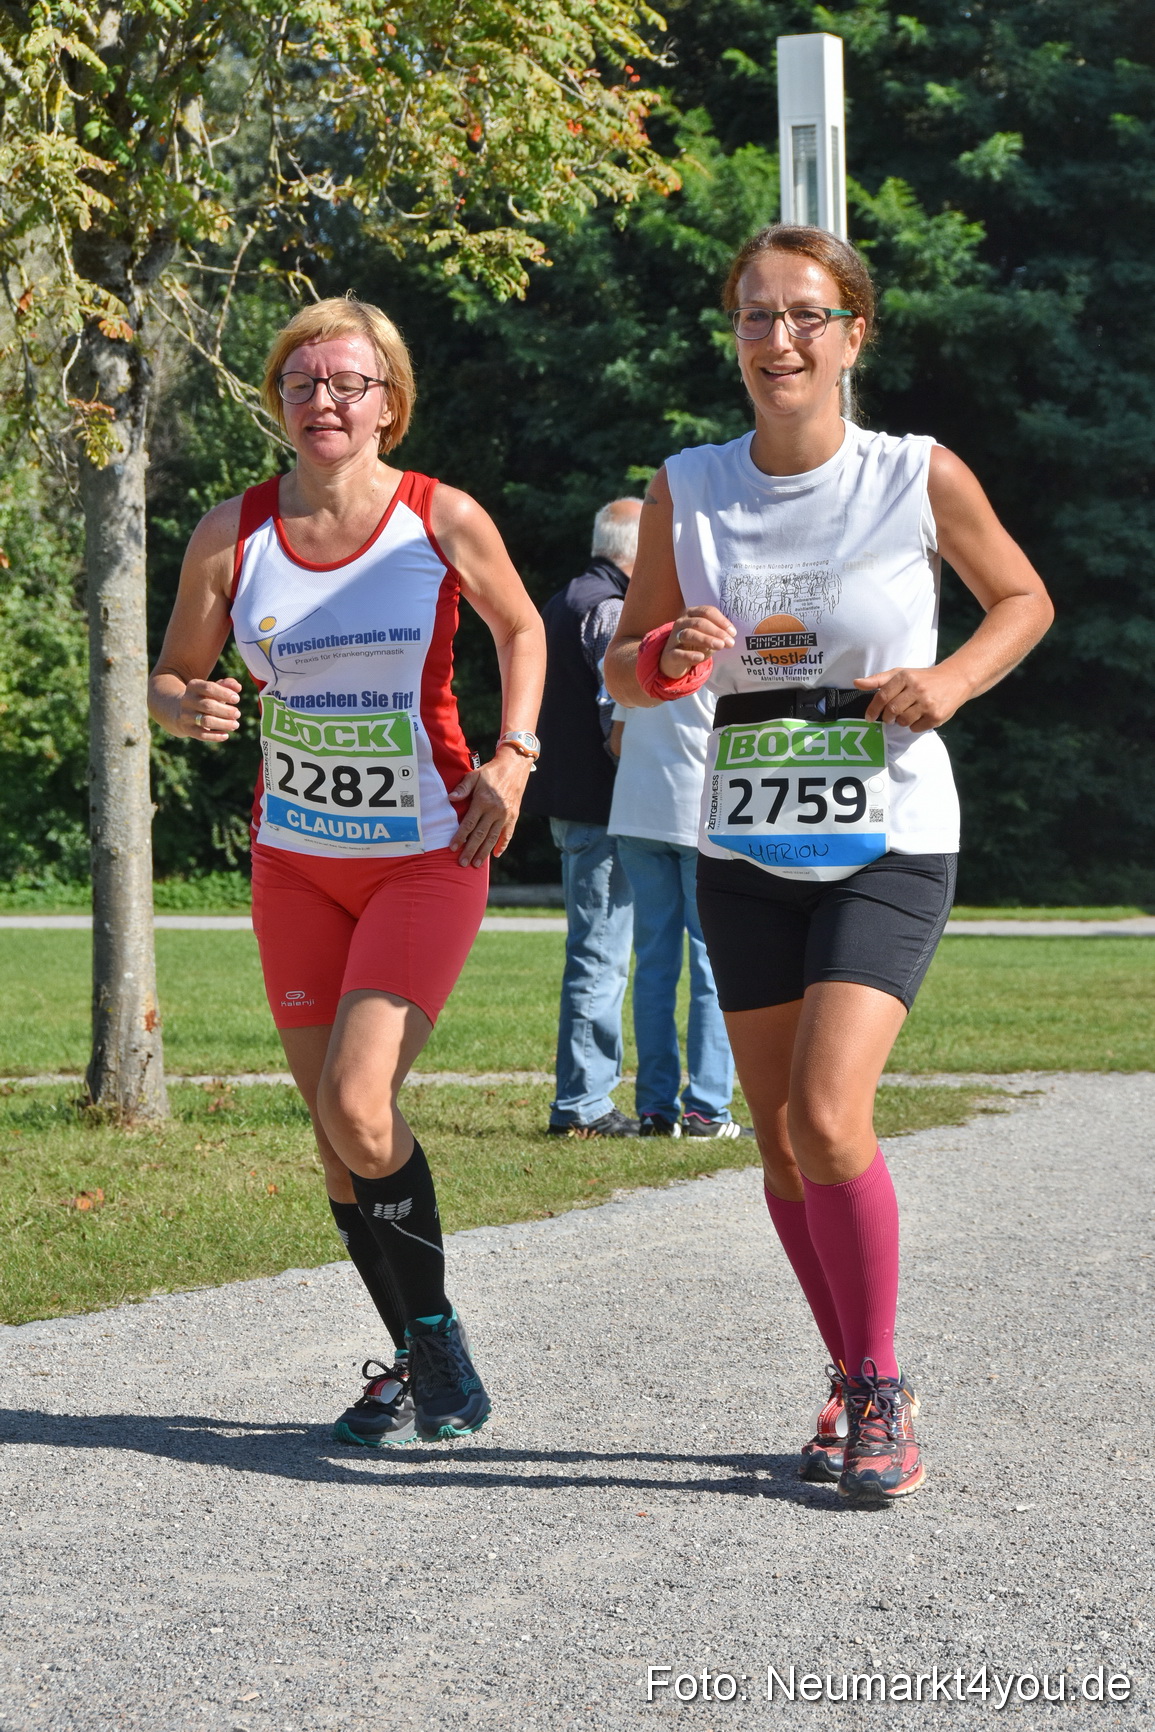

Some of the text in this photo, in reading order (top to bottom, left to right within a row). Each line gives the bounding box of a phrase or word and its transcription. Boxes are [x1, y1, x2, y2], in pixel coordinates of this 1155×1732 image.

[802, 559, 830, 568] Bewegung
[277, 627, 421, 657] Physiotherapie Wild
[749, 633, 815, 649] FINISH LINE
[295, 656, 319, 665] Praxis
[333, 648, 404, 659] Krankengymnastik
[741, 651, 824, 666] Herbstlauf
[747, 666, 823, 676] Post SV Nürnberg
[290, 691, 357, 709] machen
[361, 690, 388, 708] Sie
[392, 691, 413, 710] fit!
[271, 704, 401, 752] BOCK
[726, 727, 872, 765] BOCK
[275, 751, 397, 808] 2282
[402, 769, 410, 777] D
[727, 776, 867, 824] 2759
[286, 809, 391, 840] CLAUDIA
[749, 843, 829, 863] MARION
